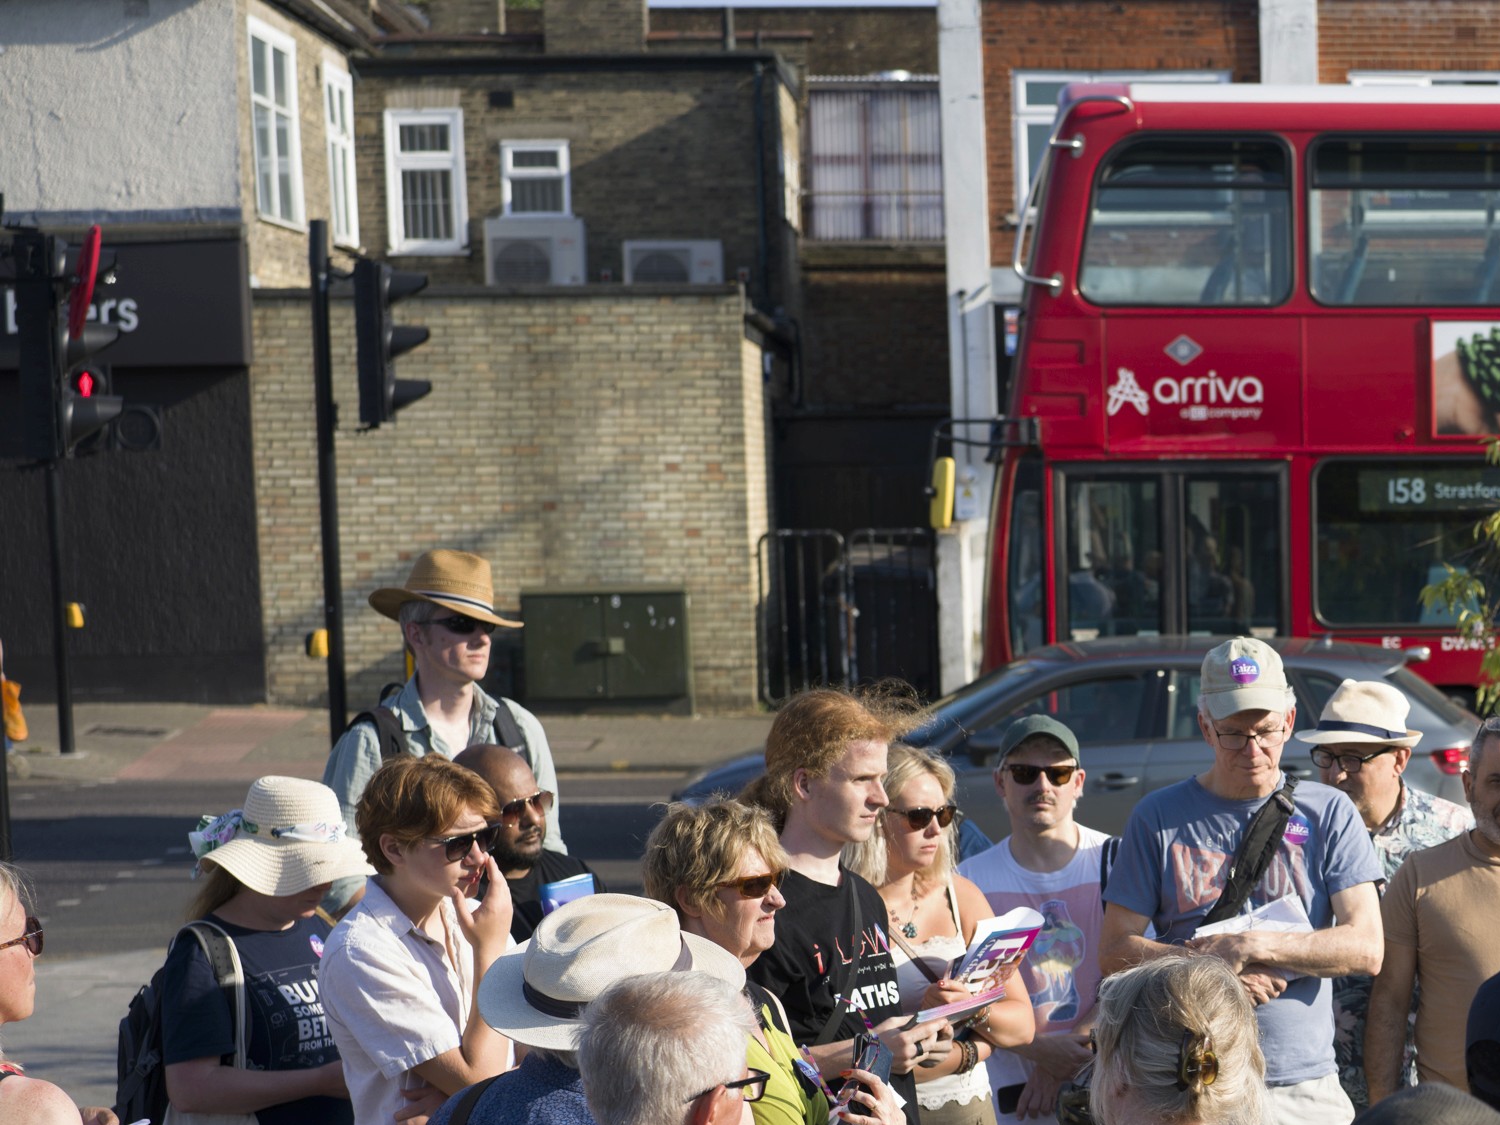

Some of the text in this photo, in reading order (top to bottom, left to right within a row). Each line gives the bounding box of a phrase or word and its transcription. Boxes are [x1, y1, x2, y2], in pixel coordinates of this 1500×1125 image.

[1153, 370, 1264, 404] arriva
[1208, 406, 1263, 420] company
[1388, 478, 1427, 504] 158
[1232, 663, 1258, 675] Faiza
[1286, 822, 1310, 834] Faiza
[834, 980, 900, 1013] ATHS
[293, 1003, 325, 1018] SOME
[297, 1016, 329, 1040] BET
[299, 1041, 322, 1051] FROM
